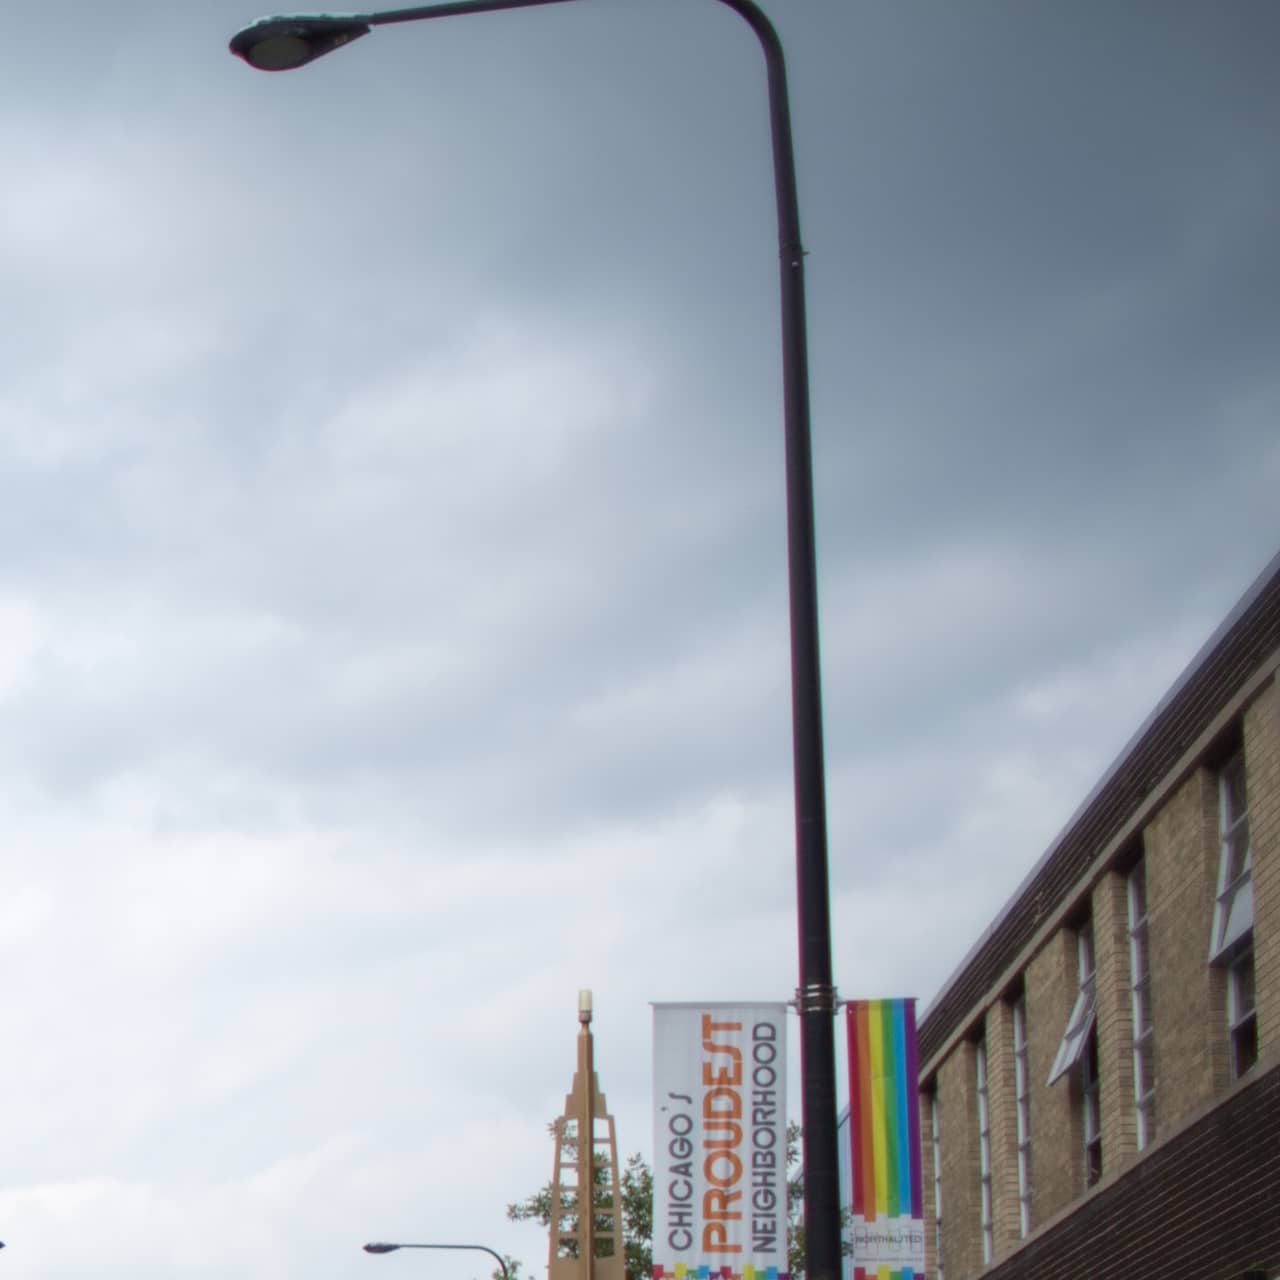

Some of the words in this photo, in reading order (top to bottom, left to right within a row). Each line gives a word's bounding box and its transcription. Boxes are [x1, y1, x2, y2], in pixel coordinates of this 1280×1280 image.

[661, 1092, 693, 1251] CHICAGO'S
[702, 1013, 743, 1254] PROUDEST
[752, 1022, 777, 1253] NEIGHBORHOOD
